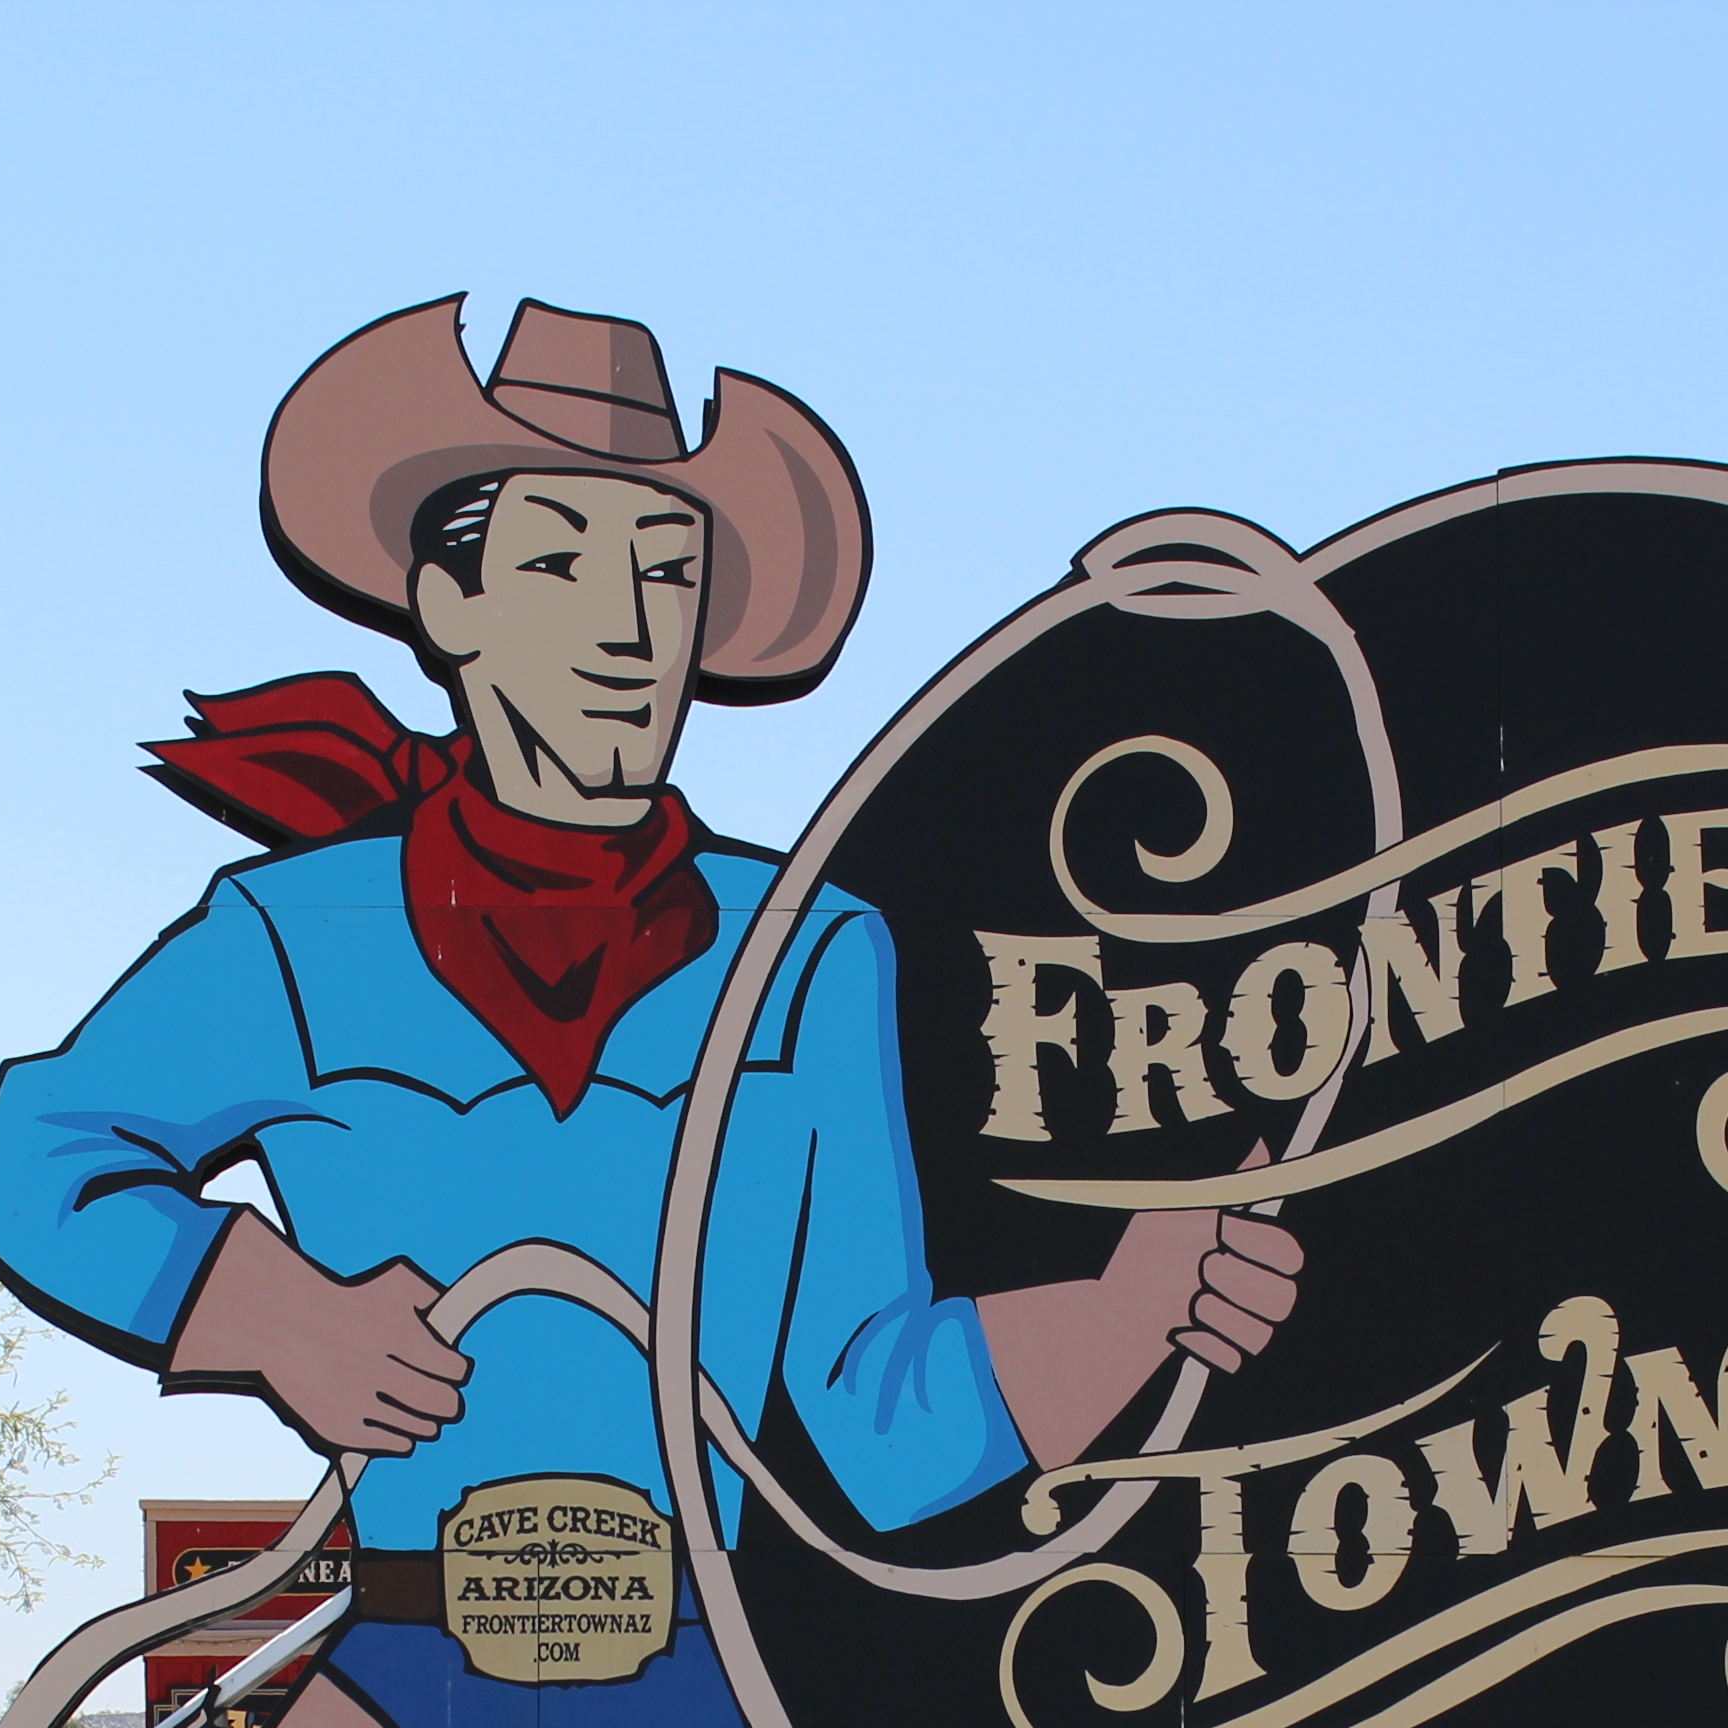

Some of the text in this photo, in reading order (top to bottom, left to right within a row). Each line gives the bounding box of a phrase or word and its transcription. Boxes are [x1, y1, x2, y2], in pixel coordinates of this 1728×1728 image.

[453, 1505, 662, 1550] CAVE CREEK
[457, 1575, 654, 1601] ARIZONA
[461, 1613, 652, 1635] FRONTIERTOWNAZ
[533, 1642, 581, 1663] .COM
